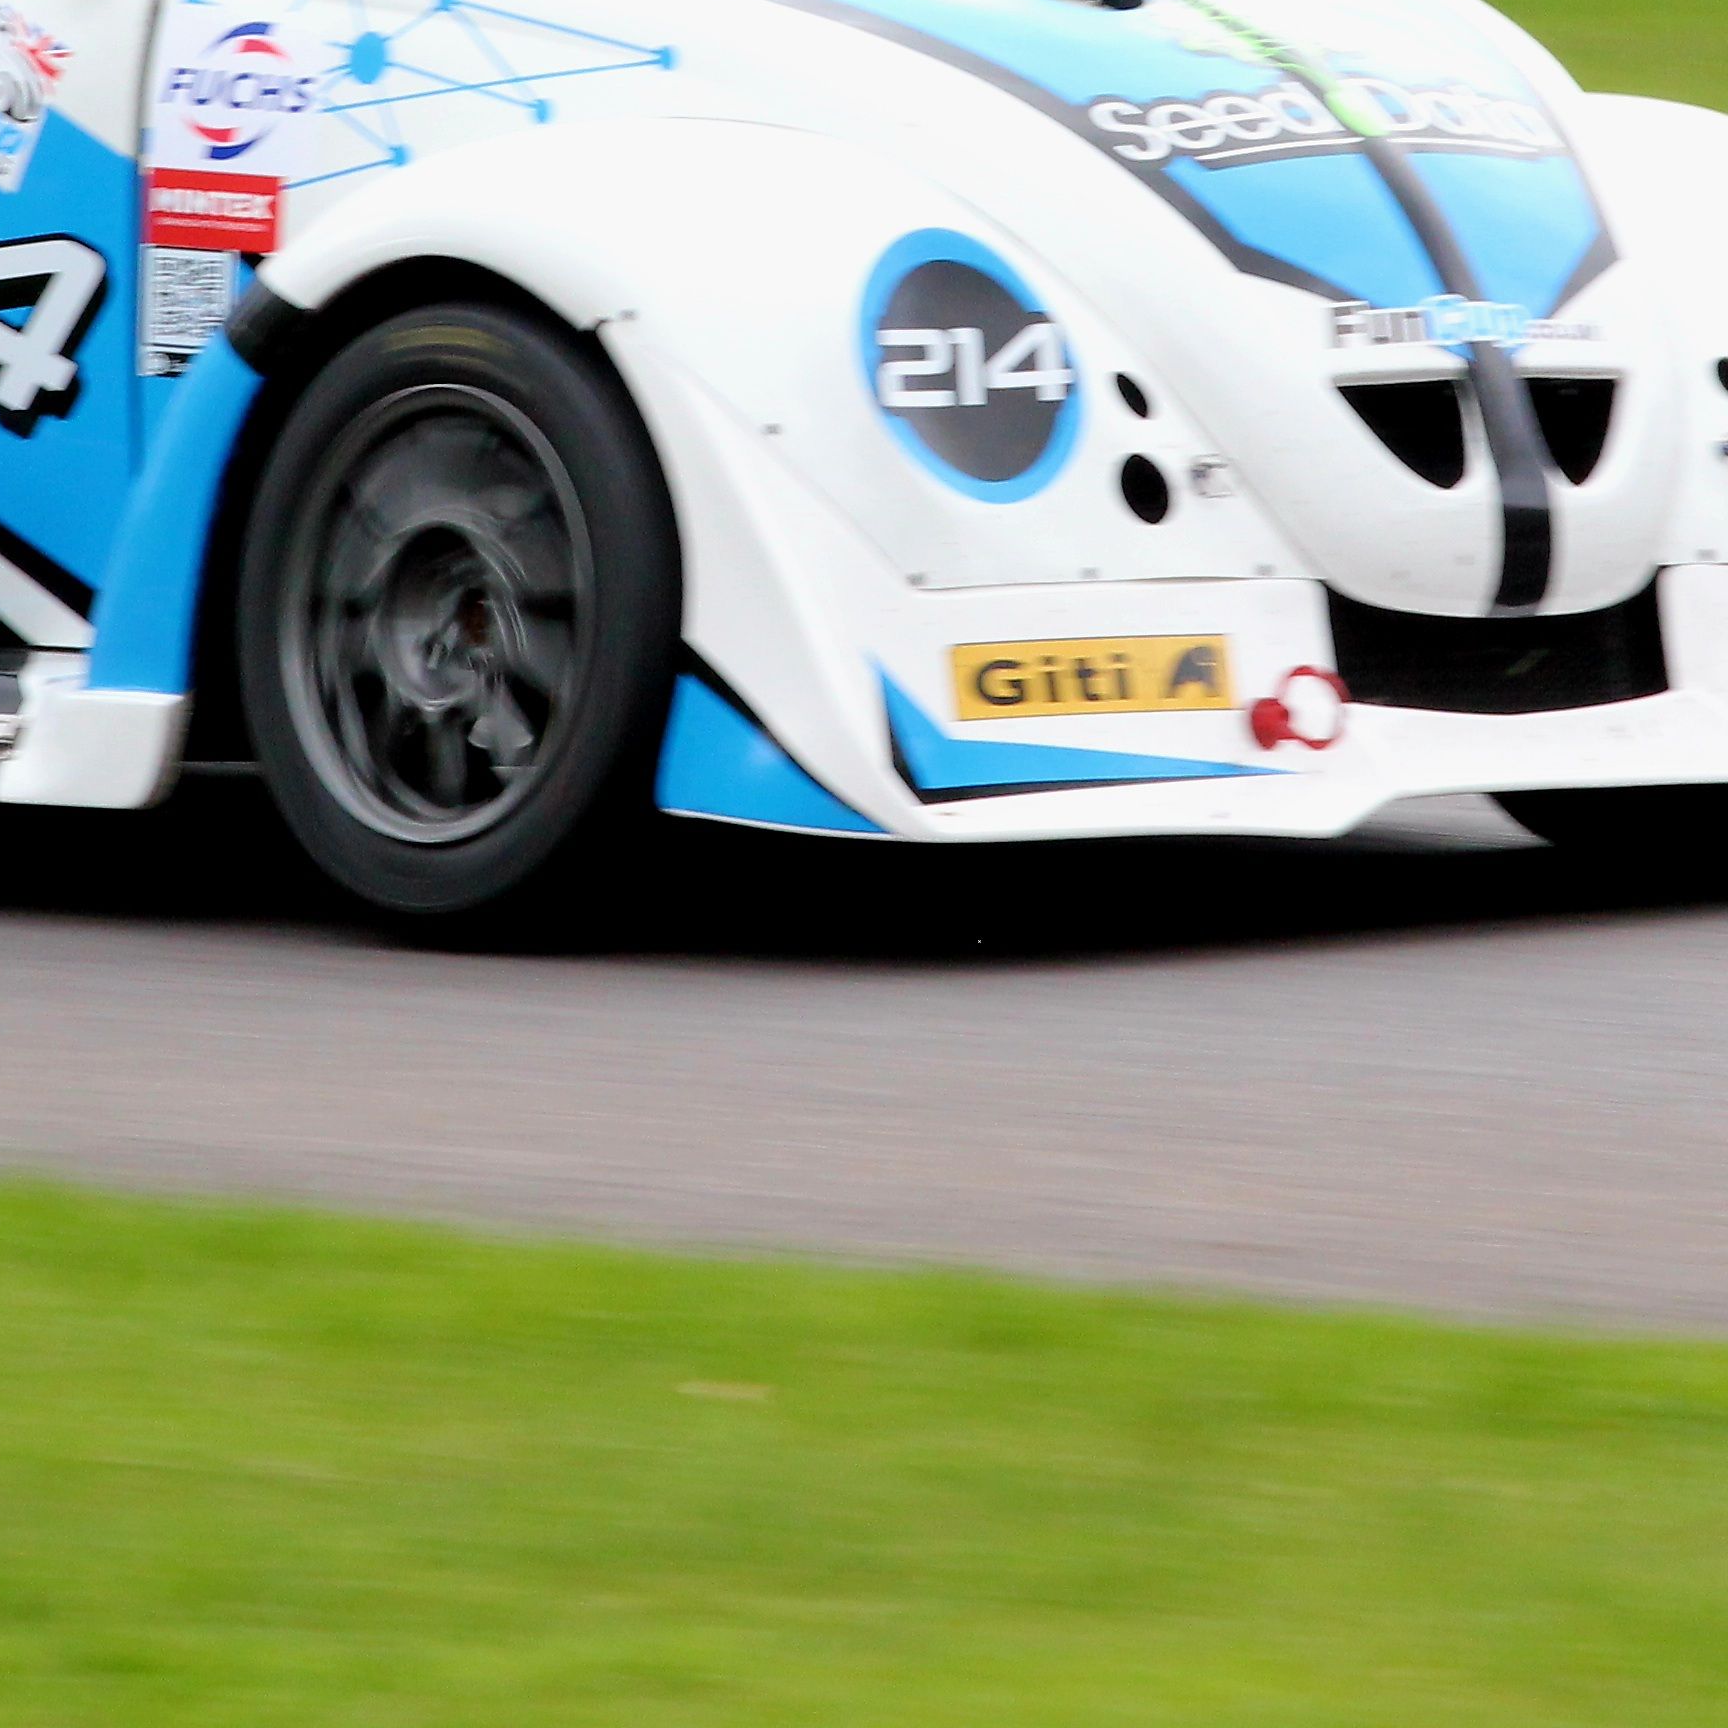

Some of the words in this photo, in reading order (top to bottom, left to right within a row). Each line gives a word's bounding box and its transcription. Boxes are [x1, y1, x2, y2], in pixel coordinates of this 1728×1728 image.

[160, 67, 317, 113] FUCHS
[1087, 79, 1348, 161] Seed
[1332, 77, 1565, 148] Data
[875, 321, 1074, 409] 214
[976, 650, 1129, 708] Giti
